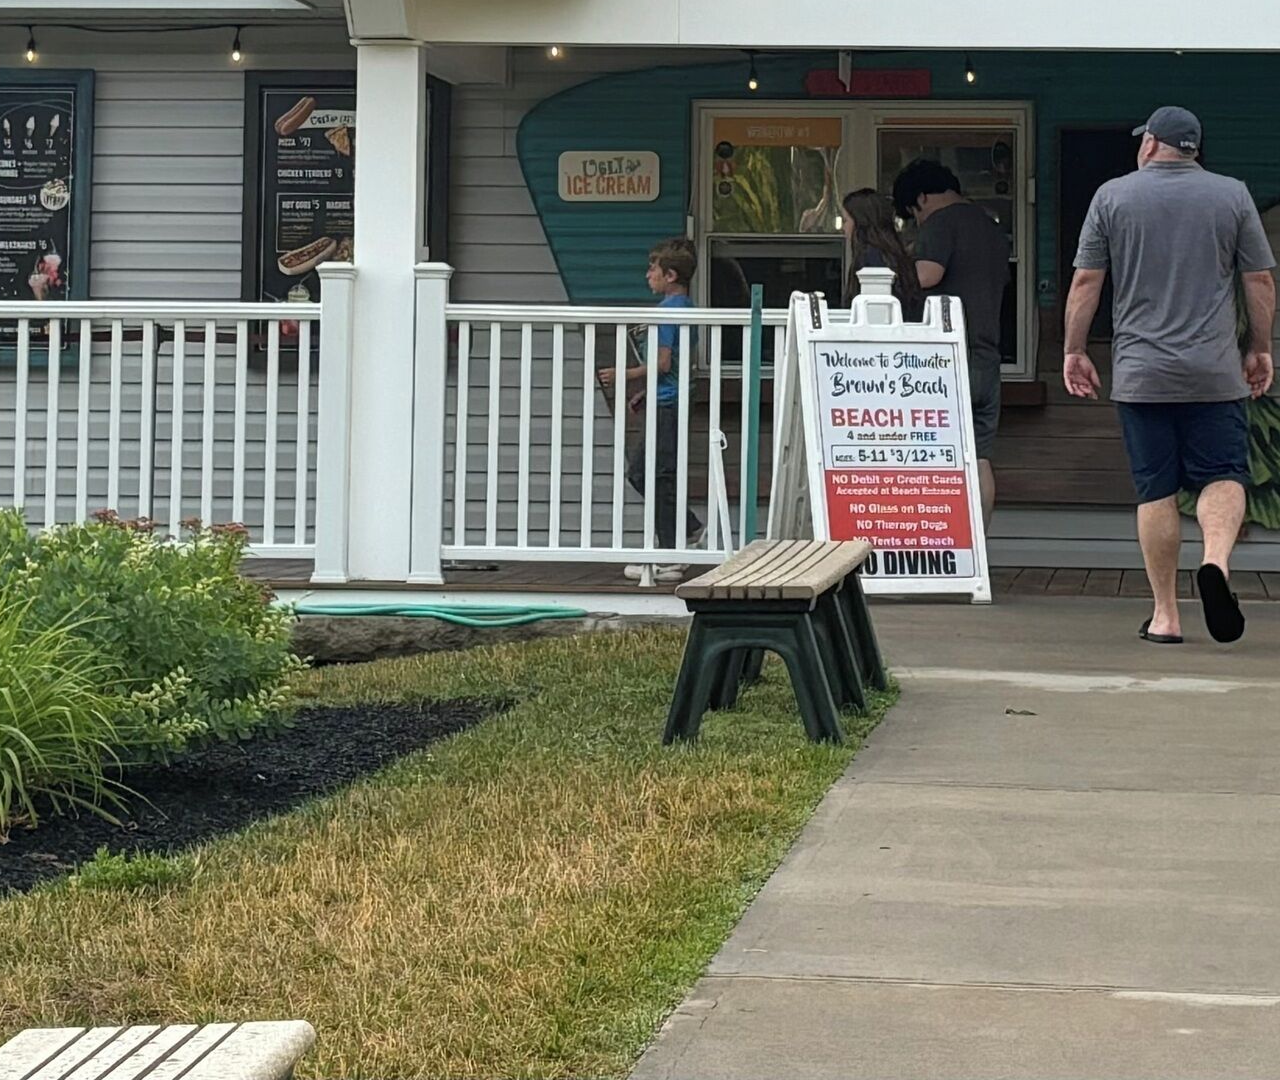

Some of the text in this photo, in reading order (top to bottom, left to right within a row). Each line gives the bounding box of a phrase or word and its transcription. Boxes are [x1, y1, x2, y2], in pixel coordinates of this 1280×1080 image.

[582, 157, 624, 177] UGLY
[567, 175, 651, 195] ICE CREAM
[820, 350, 951, 370] Welcome to Stillwater
[830, 372, 948, 398] Brown's Beach
[831, 408, 950, 427] BEACH FEE
[847, 431, 937, 441] 4 and under FREE
[939, 449, 953, 462] $5
[832, 474, 963, 485] NO Debit or Credit Cards
[836, 487, 960, 496] Accepted at Beach Entrance
[849, 503, 952, 514] NO Glass on Beach
[856, 520, 948, 531] NO Therapy Dogs
[871, 536, 901, 546] Tents
[904, 538, 917, 546] on
[920, 536, 954, 546] Beach
[883, 550, 957, 575] DIVING
